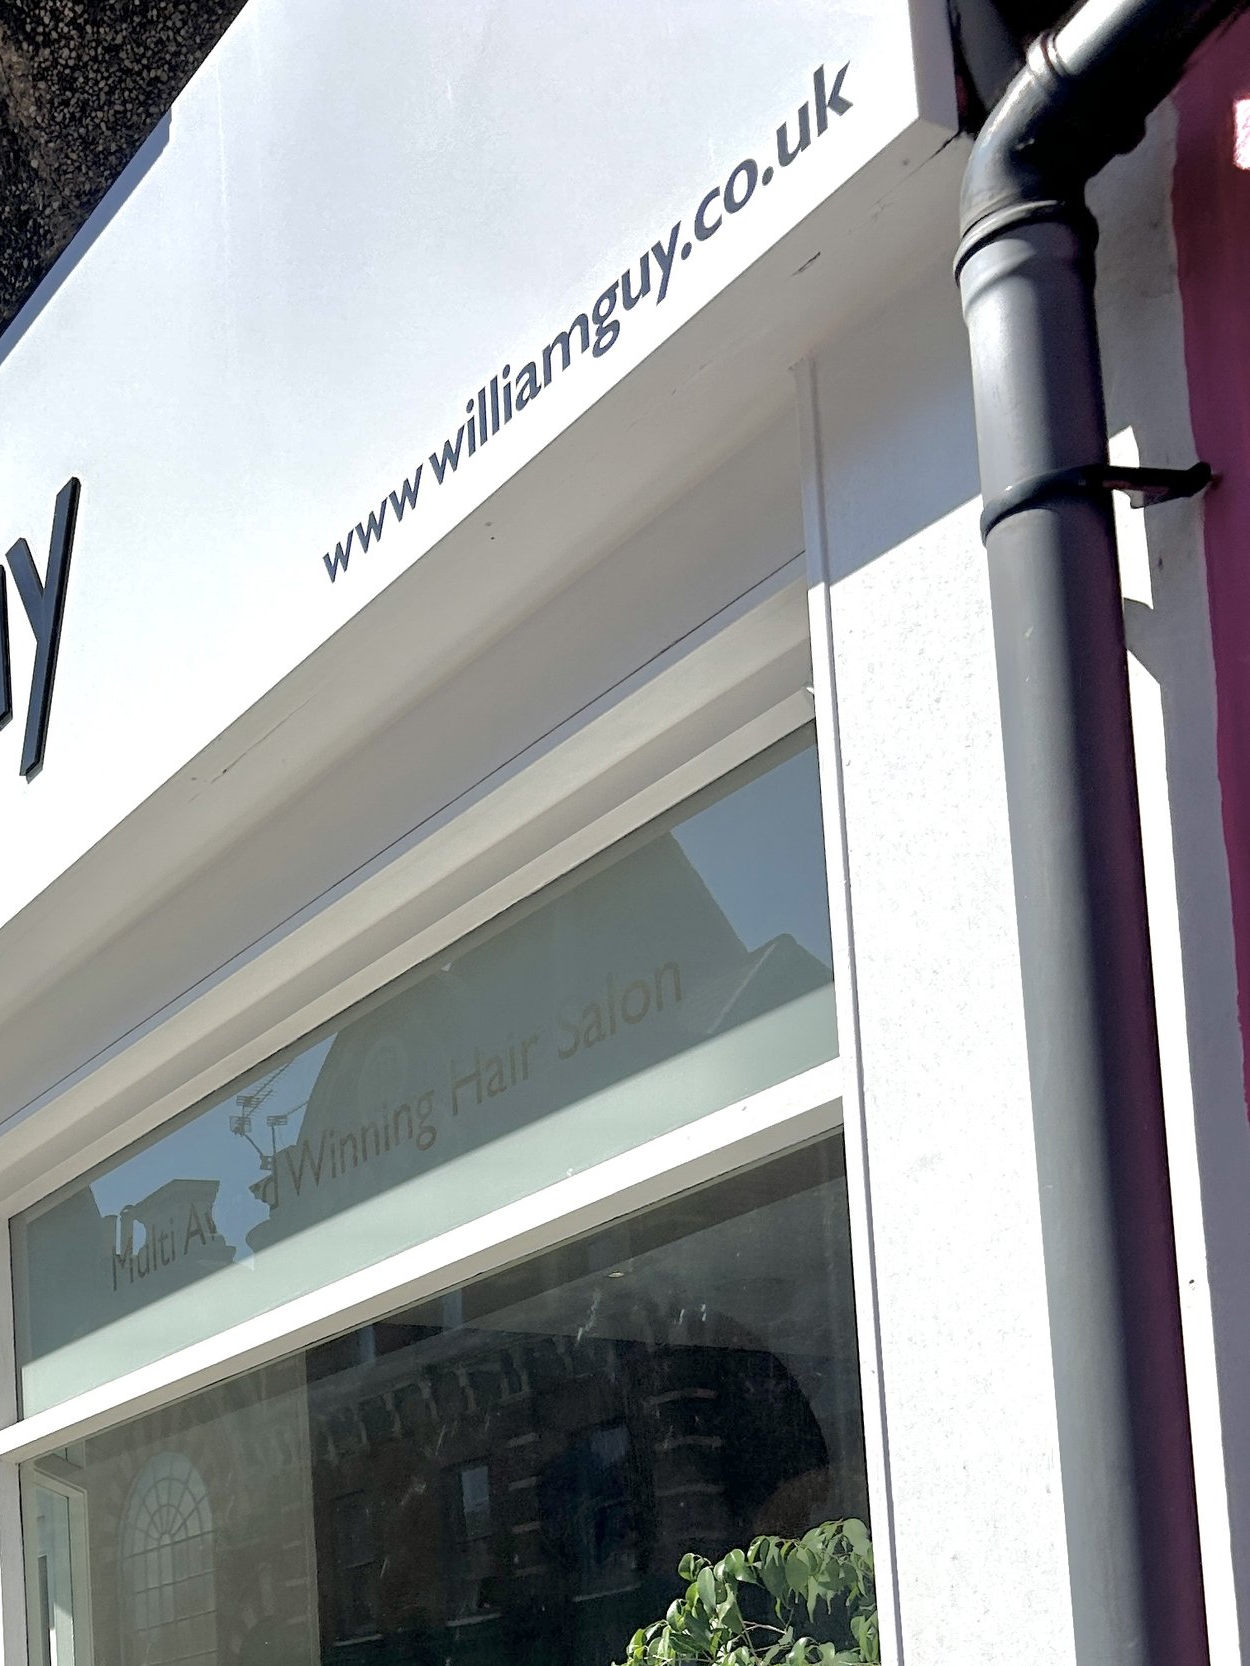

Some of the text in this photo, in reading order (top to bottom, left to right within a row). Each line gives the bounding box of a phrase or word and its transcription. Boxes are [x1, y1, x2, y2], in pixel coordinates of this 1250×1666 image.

[287, 1087, 438, 1197] Winning
[449, 1033, 539, 1115] Hair
[557, 959, 684, 1061] Salon
